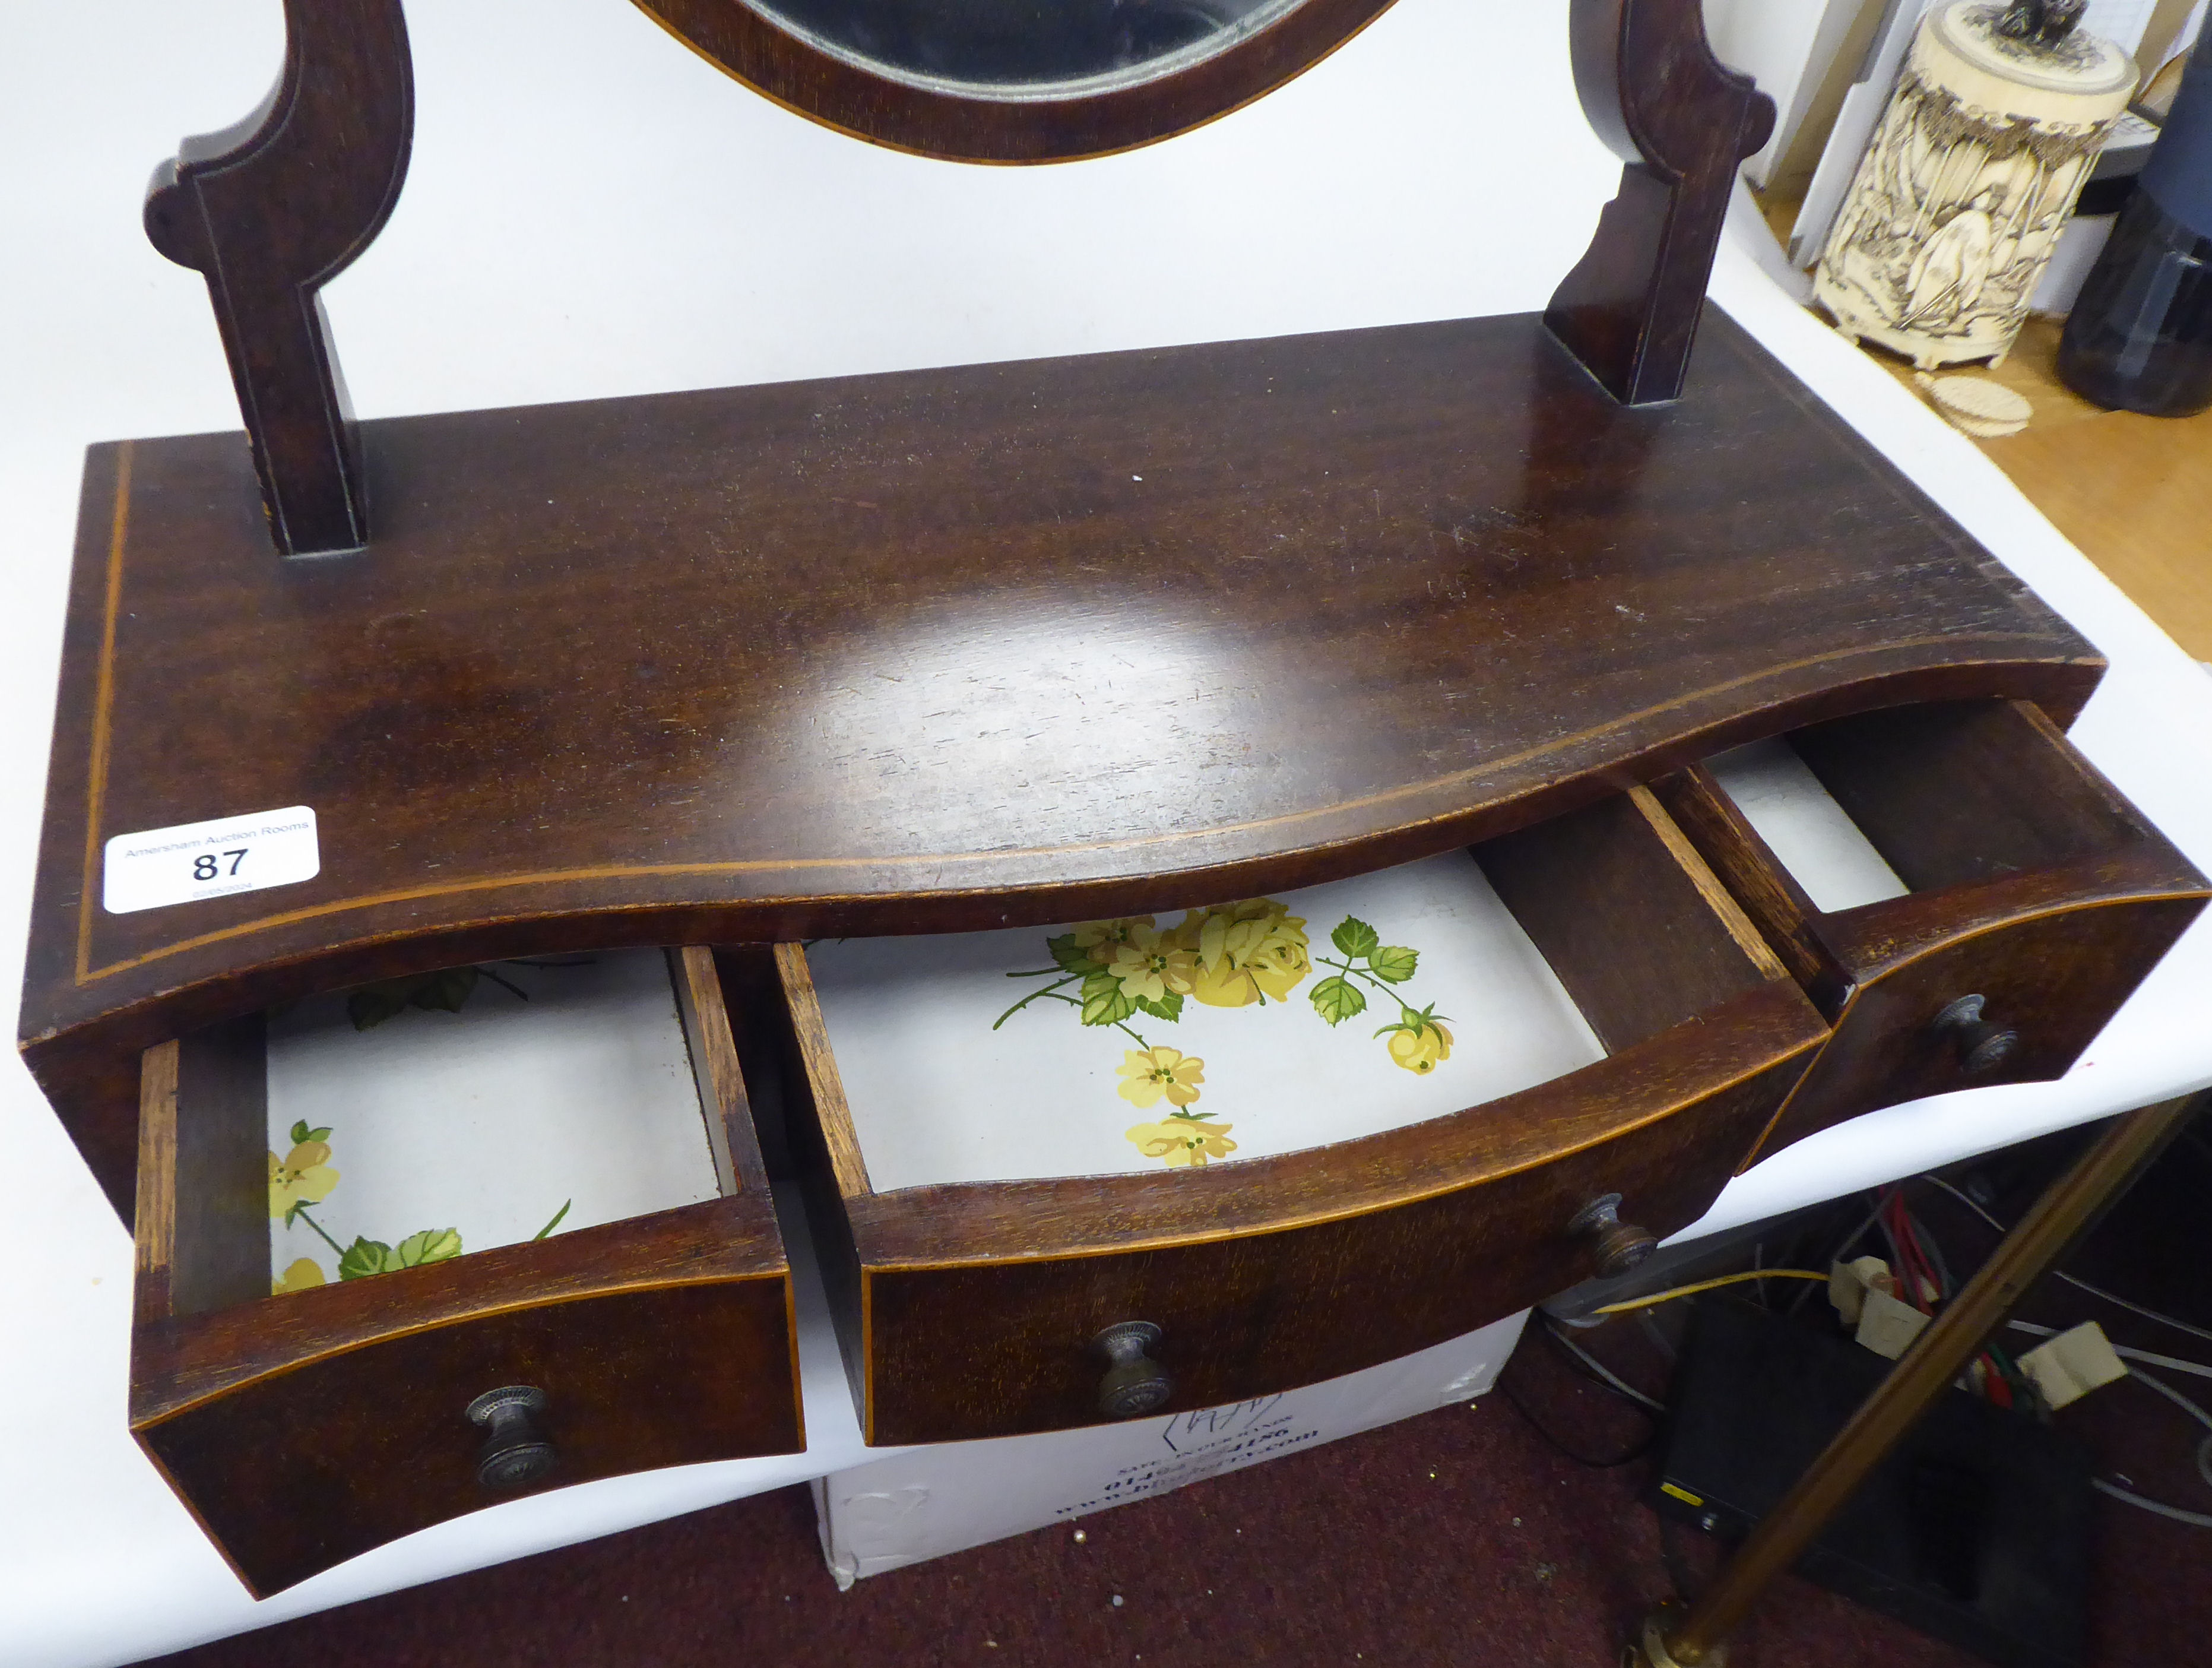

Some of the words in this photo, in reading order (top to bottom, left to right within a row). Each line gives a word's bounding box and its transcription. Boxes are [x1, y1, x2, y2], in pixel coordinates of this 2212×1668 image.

[125, 839, 201, 859] Amersham
[205, 830, 256, 846] Auction
[261, 821, 309, 836] Rooms
[193, 848, 249, 881] 87
